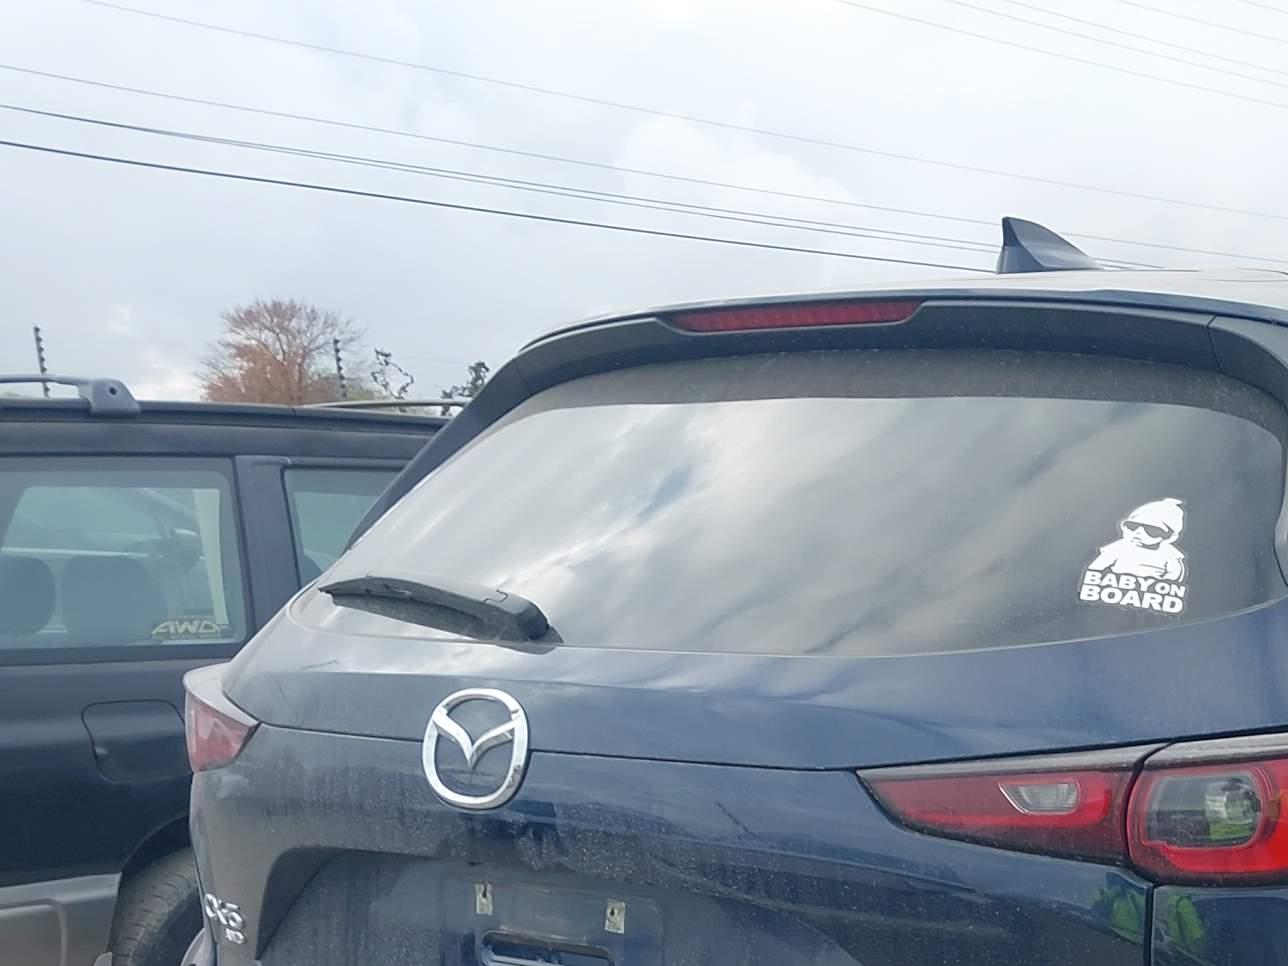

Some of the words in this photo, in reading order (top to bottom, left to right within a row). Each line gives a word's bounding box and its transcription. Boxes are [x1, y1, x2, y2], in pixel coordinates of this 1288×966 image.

[1084, 571, 1155, 592] BABY
[1155, 582, 1186, 598] ON
[1080, 585, 1184, 614] BOARD
[152, 620, 220, 635] AWD
